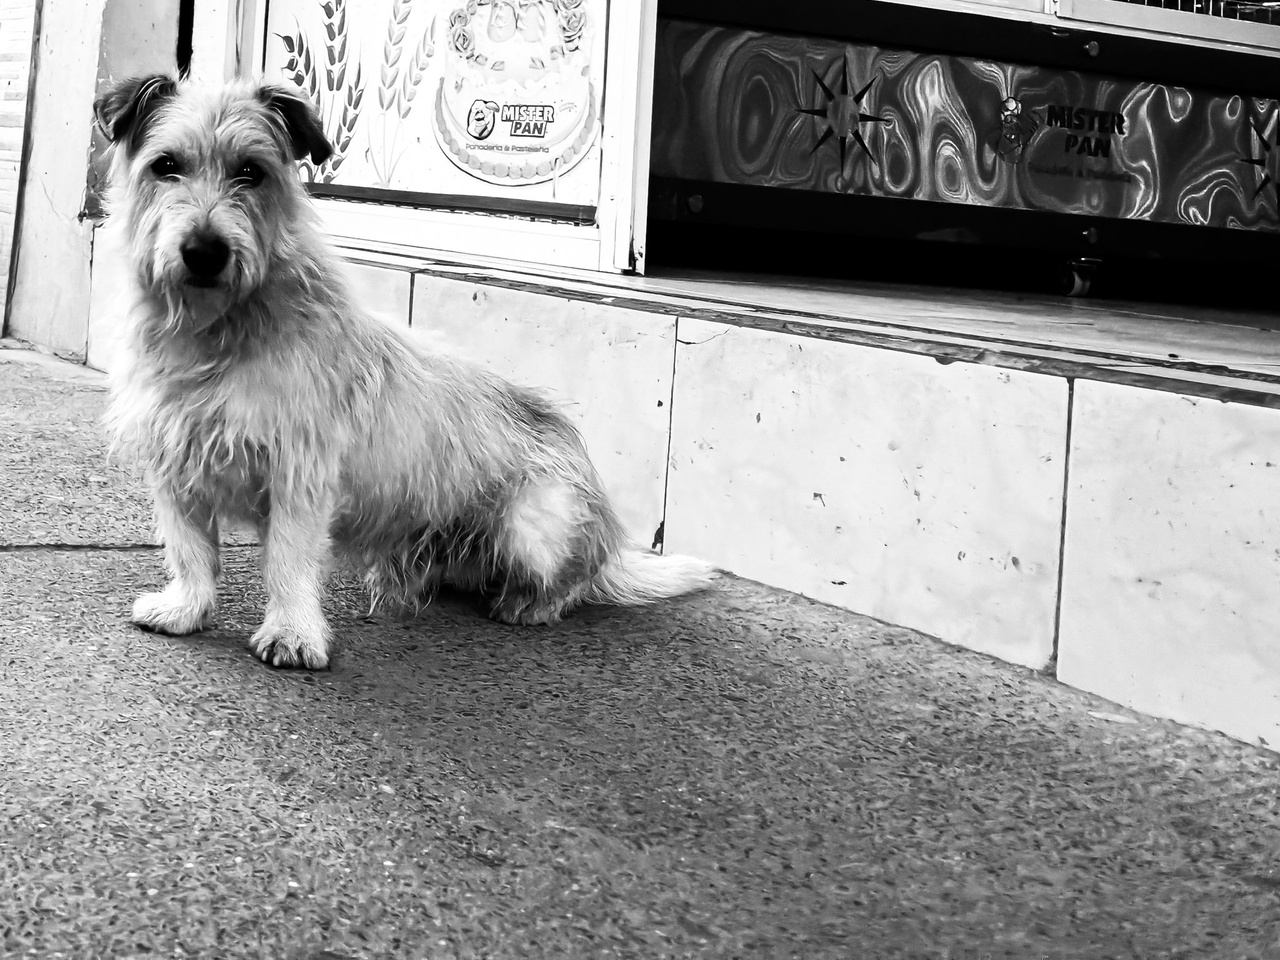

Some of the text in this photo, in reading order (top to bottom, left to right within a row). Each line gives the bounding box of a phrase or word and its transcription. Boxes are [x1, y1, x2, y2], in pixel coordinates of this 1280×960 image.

[501, 105, 554, 123] MISTER
[1046, 104, 1125, 135] MISTER
[511, 121, 546, 136] PAN
[1065, 135, 1111, 158] PAN
